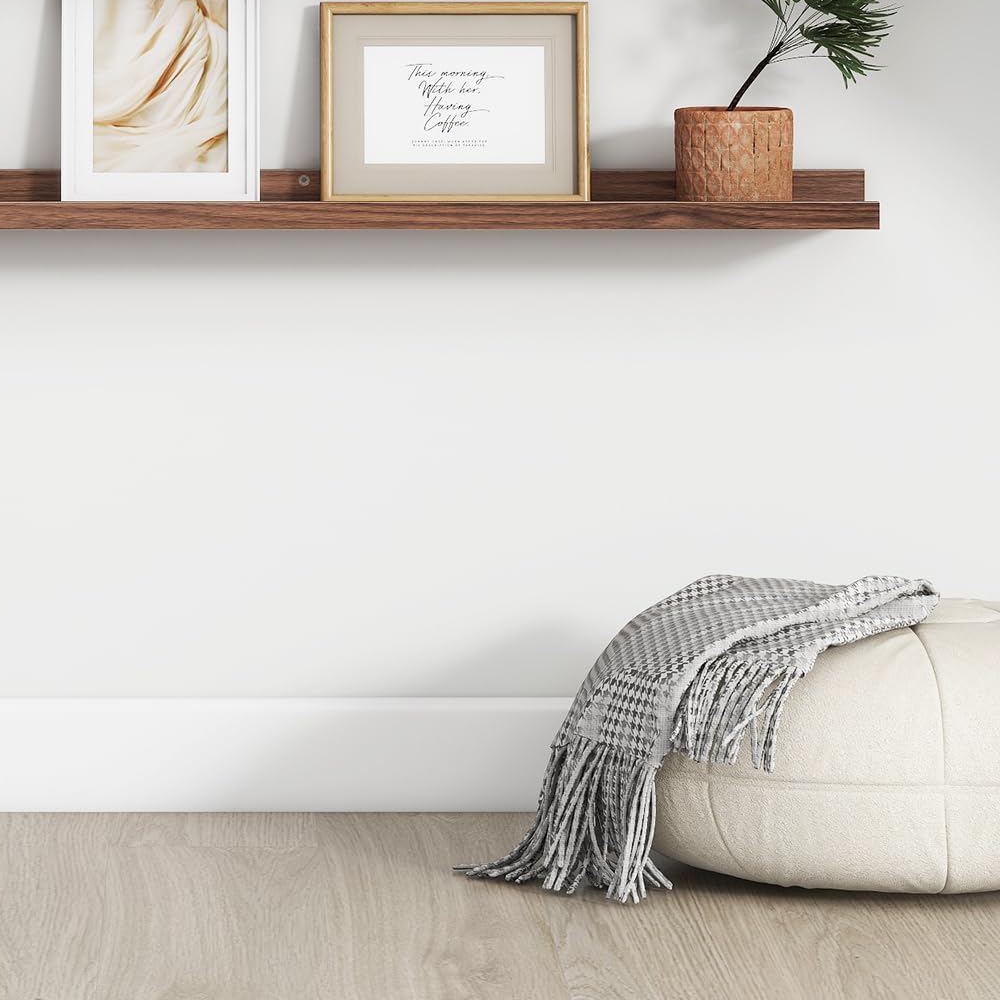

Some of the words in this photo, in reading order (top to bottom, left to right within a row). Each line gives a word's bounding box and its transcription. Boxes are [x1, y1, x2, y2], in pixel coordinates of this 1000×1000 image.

[405, 63, 436, 81] This
[418, 76, 456, 99] With
[423, 96, 491, 118] Having
